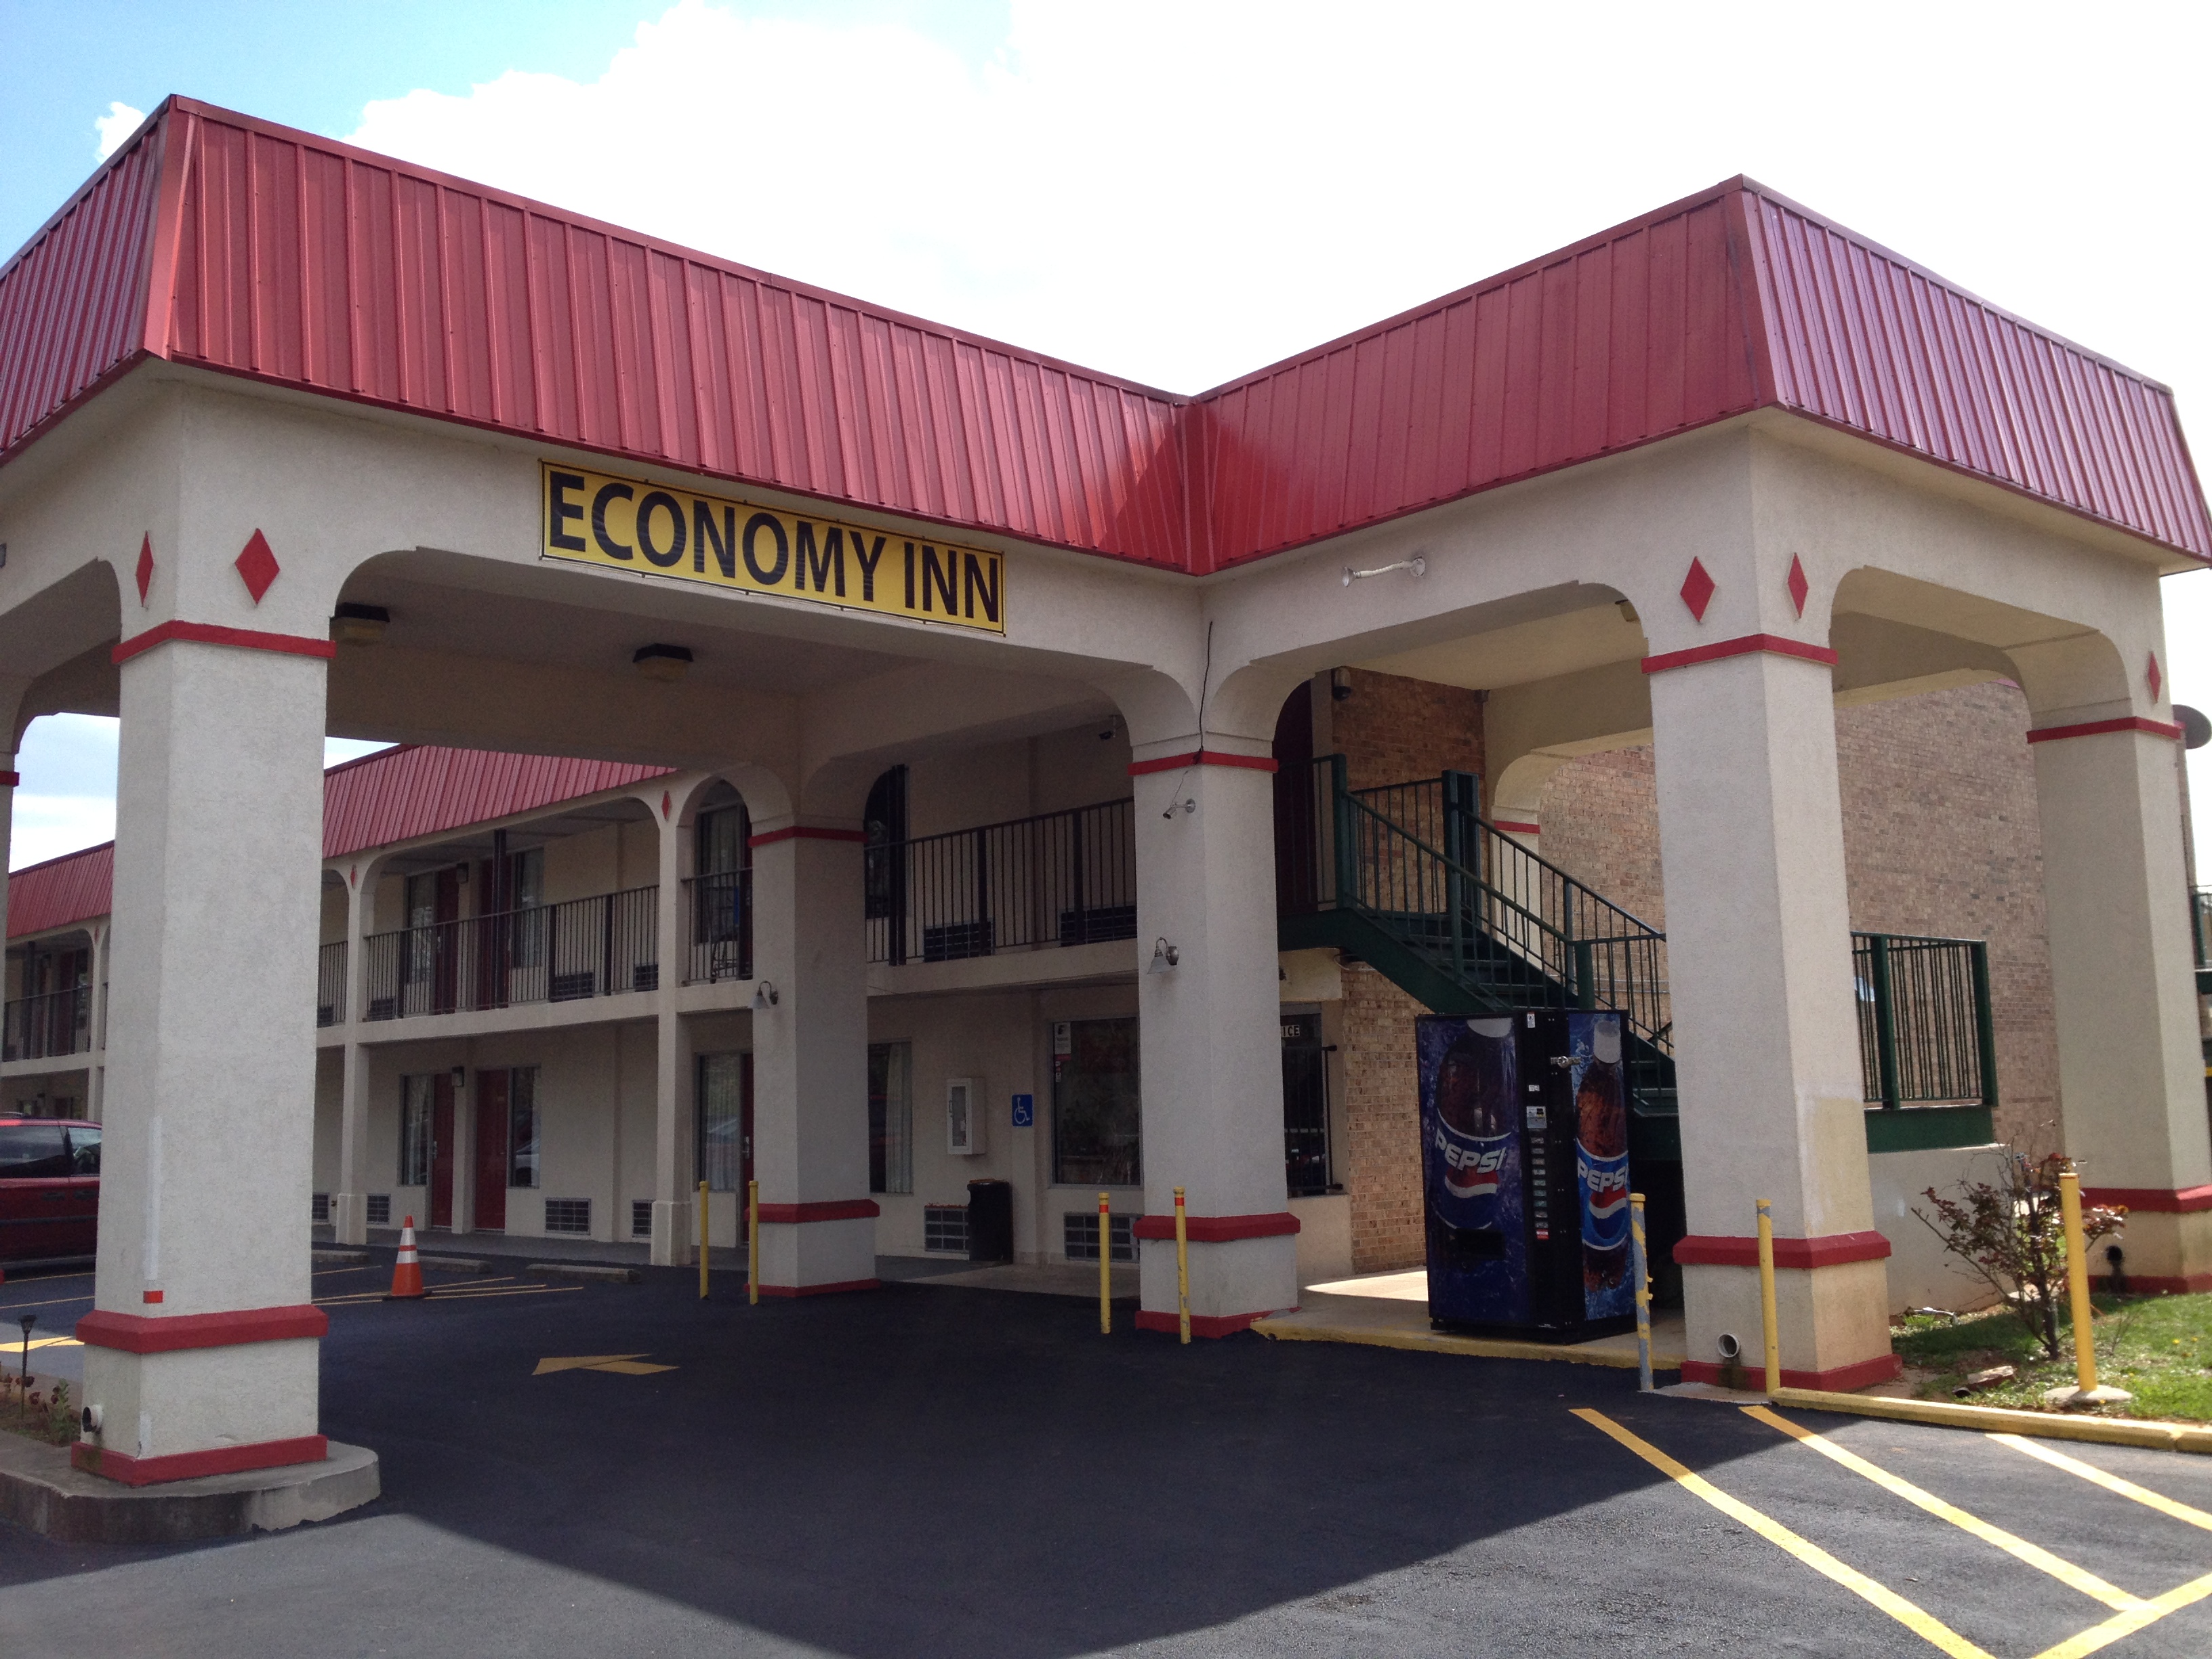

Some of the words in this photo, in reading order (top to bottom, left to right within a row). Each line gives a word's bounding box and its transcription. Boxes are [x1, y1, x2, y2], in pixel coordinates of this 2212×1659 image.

[550, 471, 886, 602] ECONOMY
[904, 541, 999, 623] INN
[1435, 1128, 1507, 1174] PEPSI
[1577, 1157, 1629, 1193] PEPSI
